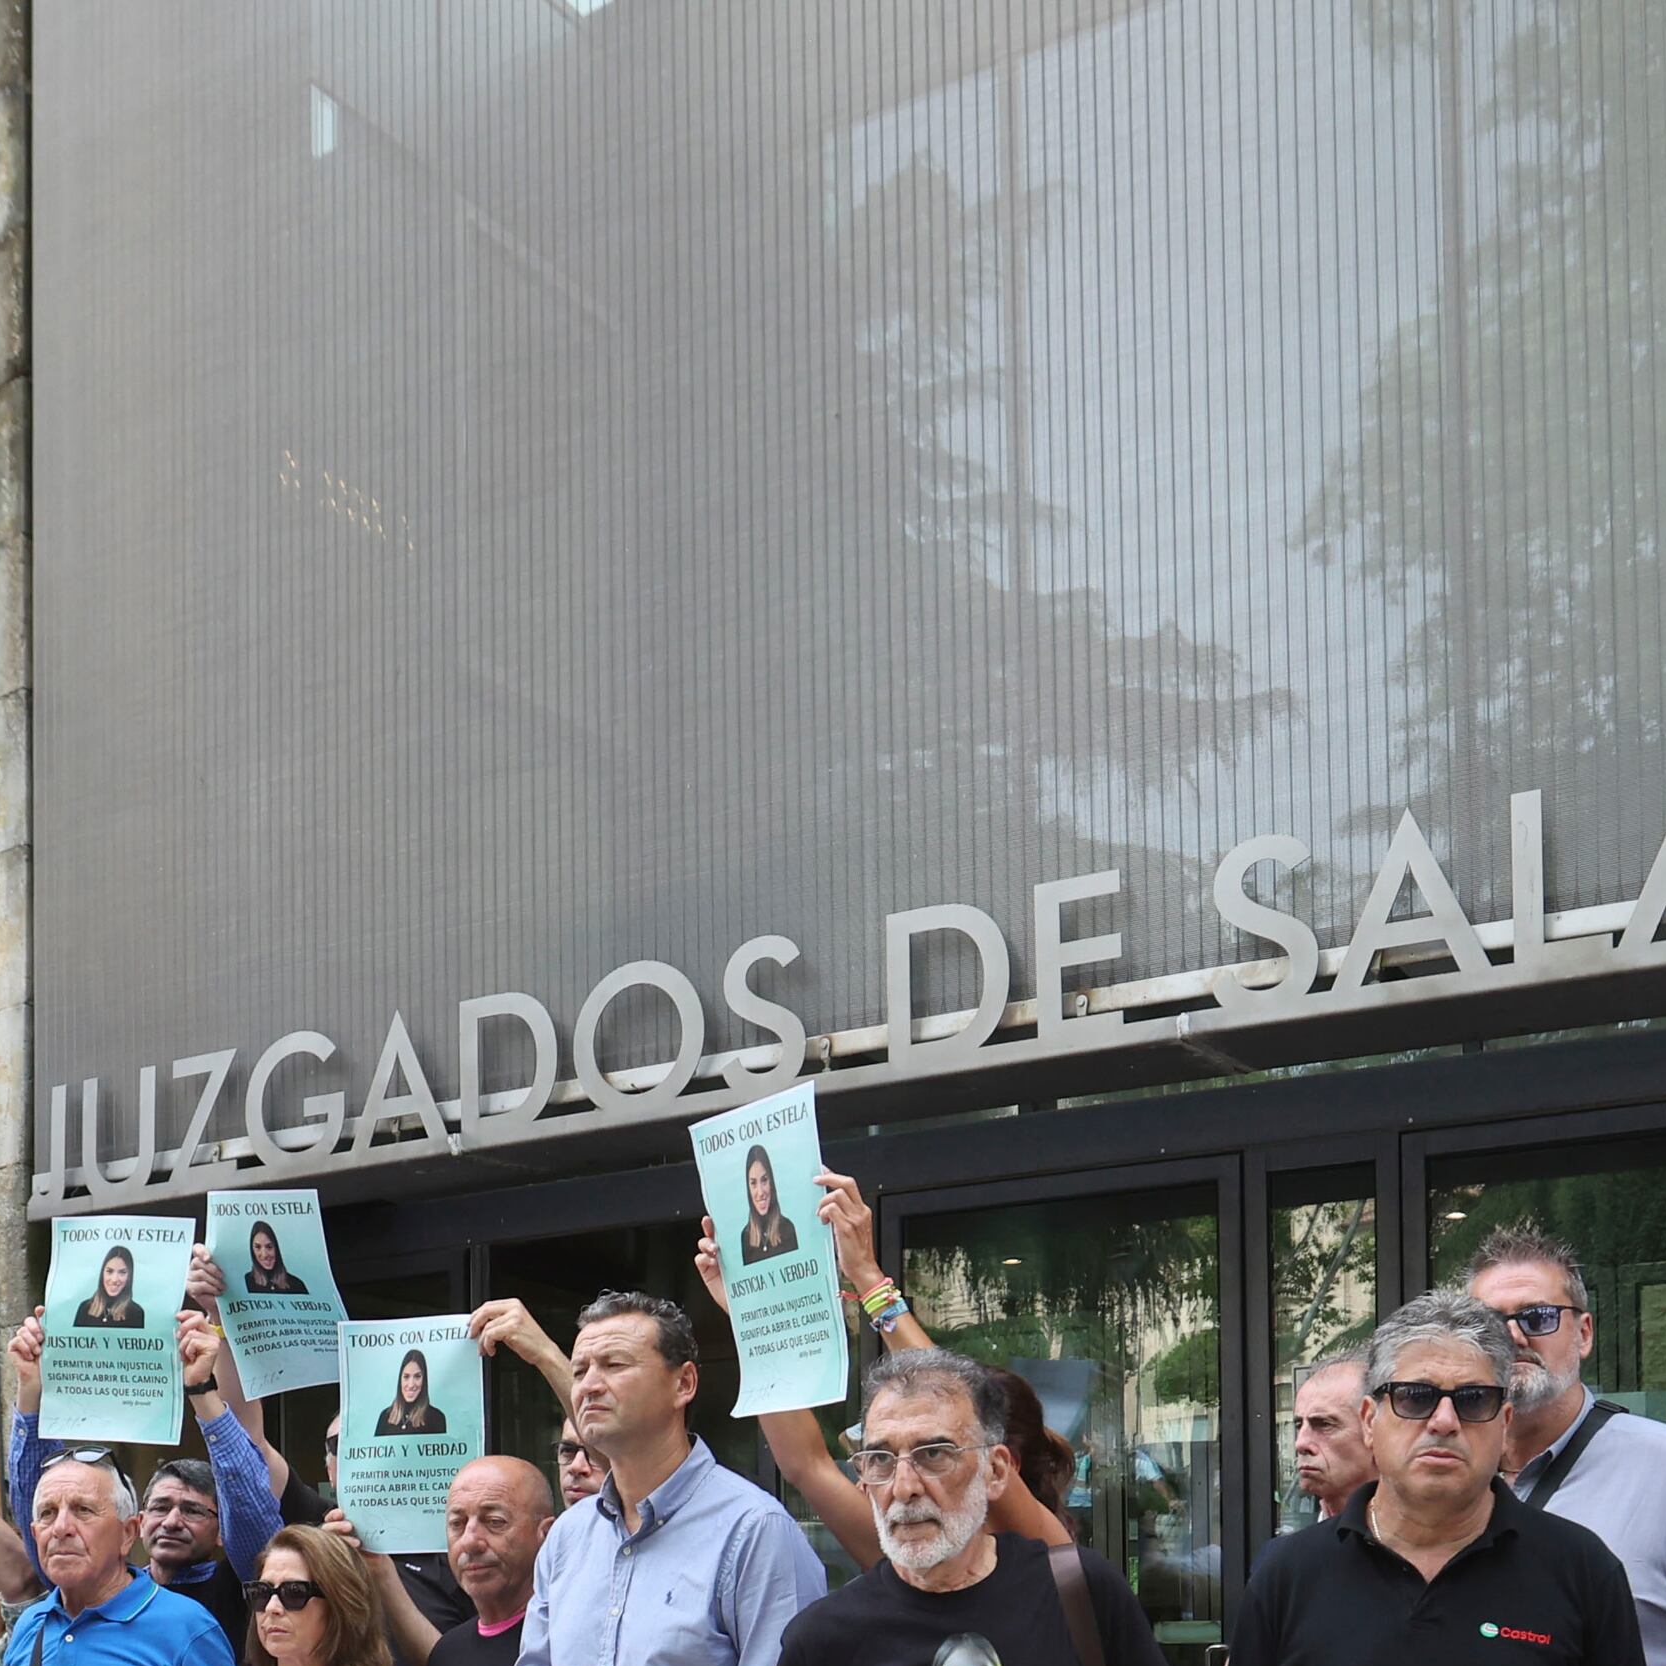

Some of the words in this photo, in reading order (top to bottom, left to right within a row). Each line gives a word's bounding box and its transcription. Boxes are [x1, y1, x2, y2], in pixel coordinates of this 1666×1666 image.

[31, 934, 806, 1196] JUZGADOS
[886, 868, 1124, 1073] DE
[698, 1129, 734, 1156] TODOS
[739, 1119, 763, 1141] CON
[767, 1102, 808, 1132] ESTELA
[245, 1203, 267, 1215] CON
[273, 1202, 313, 1215] ESTELA
[61, 1229, 99, 1242] TODOS
[105, 1228, 131, 1241] CON
[138, 1229, 185, 1243] ESTELA
[731, 1272, 767, 1299] JUSTICIA
[769, 1270, 776, 1286] Y
[782, 1259, 818, 1285] VERDAD
[227, 1300, 276, 1315] JUSTICIA
[281, 1300, 286, 1310] Y
[291, 1301, 331, 1312] VERDAD
[741, 1306, 771, 1322] PERMITIR
[770, 1302, 785, 1315] UNA
[786, 1292, 823, 1313] INJUSTICIA
[237, 1319, 277, 1331] PERMITIR
[740, 1325, 771, 1342] SIGNIFICA
[772, 1319, 792, 1333] ABRIR
[793, 1317, 801, 1328] EL
[802, 1310, 830, 1326] CAMINO
[46, 1337, 98, 1348] JUSTICIA
[104, 1337, 110, 1348] Y
[118, 1338, 164, 1350] VERDAD
[235, 1331, 277, 1345] SIGNIFICA
[348, 1333, 395, 1348] TODOS
[400, 1331, 424, 1344] CON
[749, 1346, 754, 1357] A
[754, 1343, 775, 1356] TODAS
[776, 1339, 788, 1352] LAS
[789, 1336, 803, 1349] QUE
[805, 1329, 829, 1345] SIGUEN
[251, 1343, 282, 1354] TODAS
[53, 1360, 93, 1369] PERMITIR
[96, 1361, 114, 1369] UNA
[117, 1361, 163, 1372] INJUSTICIA
[48, 1373, 90, 1382] SIGNIFICA
[93, 1374, 117, 1383] ABRIR
[121, 1375, 130, 1383] EL
[132, 1375, 168, 1384] CAMINO
[65, 1387, 93, 1395] TODAS
[95, 1388, 109, 1396] LAS
[112, 1388, 129, 1397] QUE
[132, 1388, 164, 1397] SIGUEN
[345, 1447, 396, 1460] JUSTICIA
[402, 1445, 408, 1456] Y
[418, 1443, 467, 1457] VERDAD
[351, 1470, 389, 1479] PERMITIR
[392, 1469, 413, 1478] UNA
[344, 1484, 385, 1494] SIGNIFICA
[388, 1483, 416, 1492] ABRIR
[419, 1482, 429, 1491] EL
[350, 1499, 356, 1507] A
[358, 1498, 388, 1507] TODAS
[391, 1497, 408, 1506] LAS
[410, 1497, 430, 1506] QUE
[1501, 1627, 1550, 1644] Castrol
